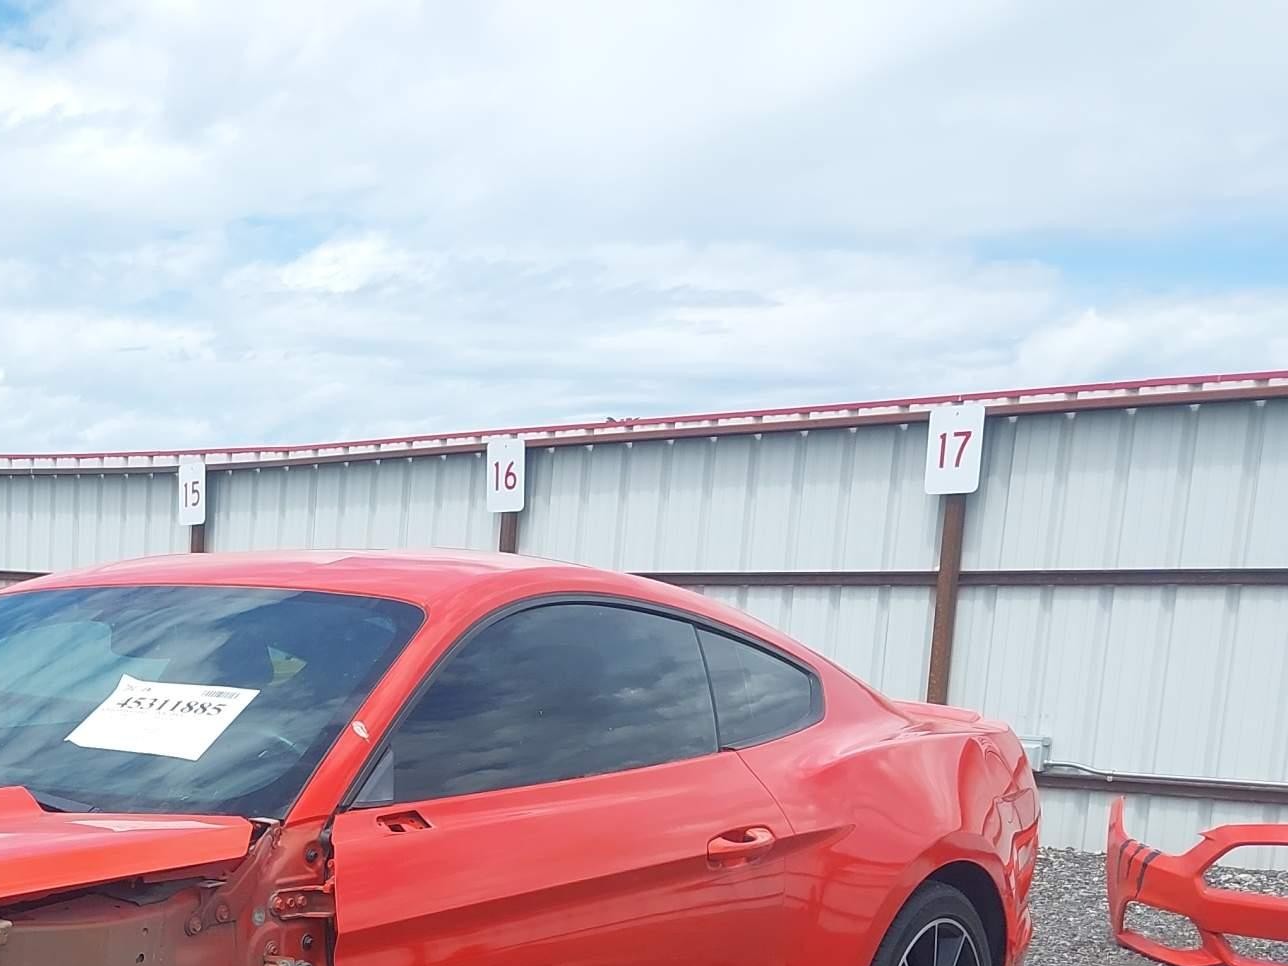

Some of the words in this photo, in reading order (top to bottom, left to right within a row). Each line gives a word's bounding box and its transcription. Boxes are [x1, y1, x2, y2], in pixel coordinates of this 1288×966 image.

[939, 431, 972, 468] 17
[494, 461, 517, 491] 16
[184, 481, 200, 508] 15
[115, 696, 228, 716] 45311885
